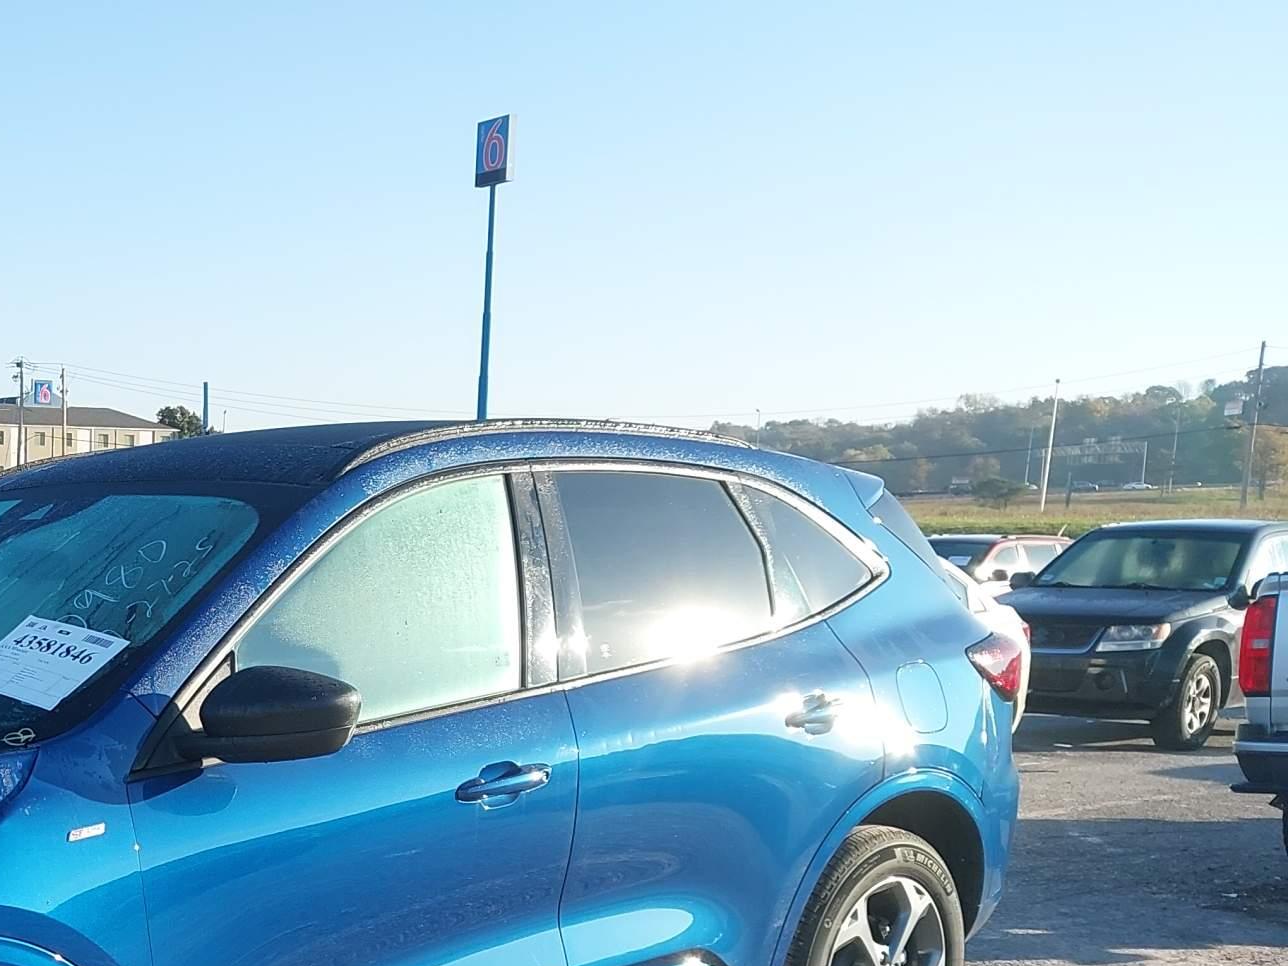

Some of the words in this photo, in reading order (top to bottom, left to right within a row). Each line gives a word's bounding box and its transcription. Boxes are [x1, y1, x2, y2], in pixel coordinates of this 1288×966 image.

[483, 119, 505, 171] 6
[40, 384, 50, 404] 6
[13, 634, 99, 665] 43581846
[915, 853, 953, 894] MICHELIN
